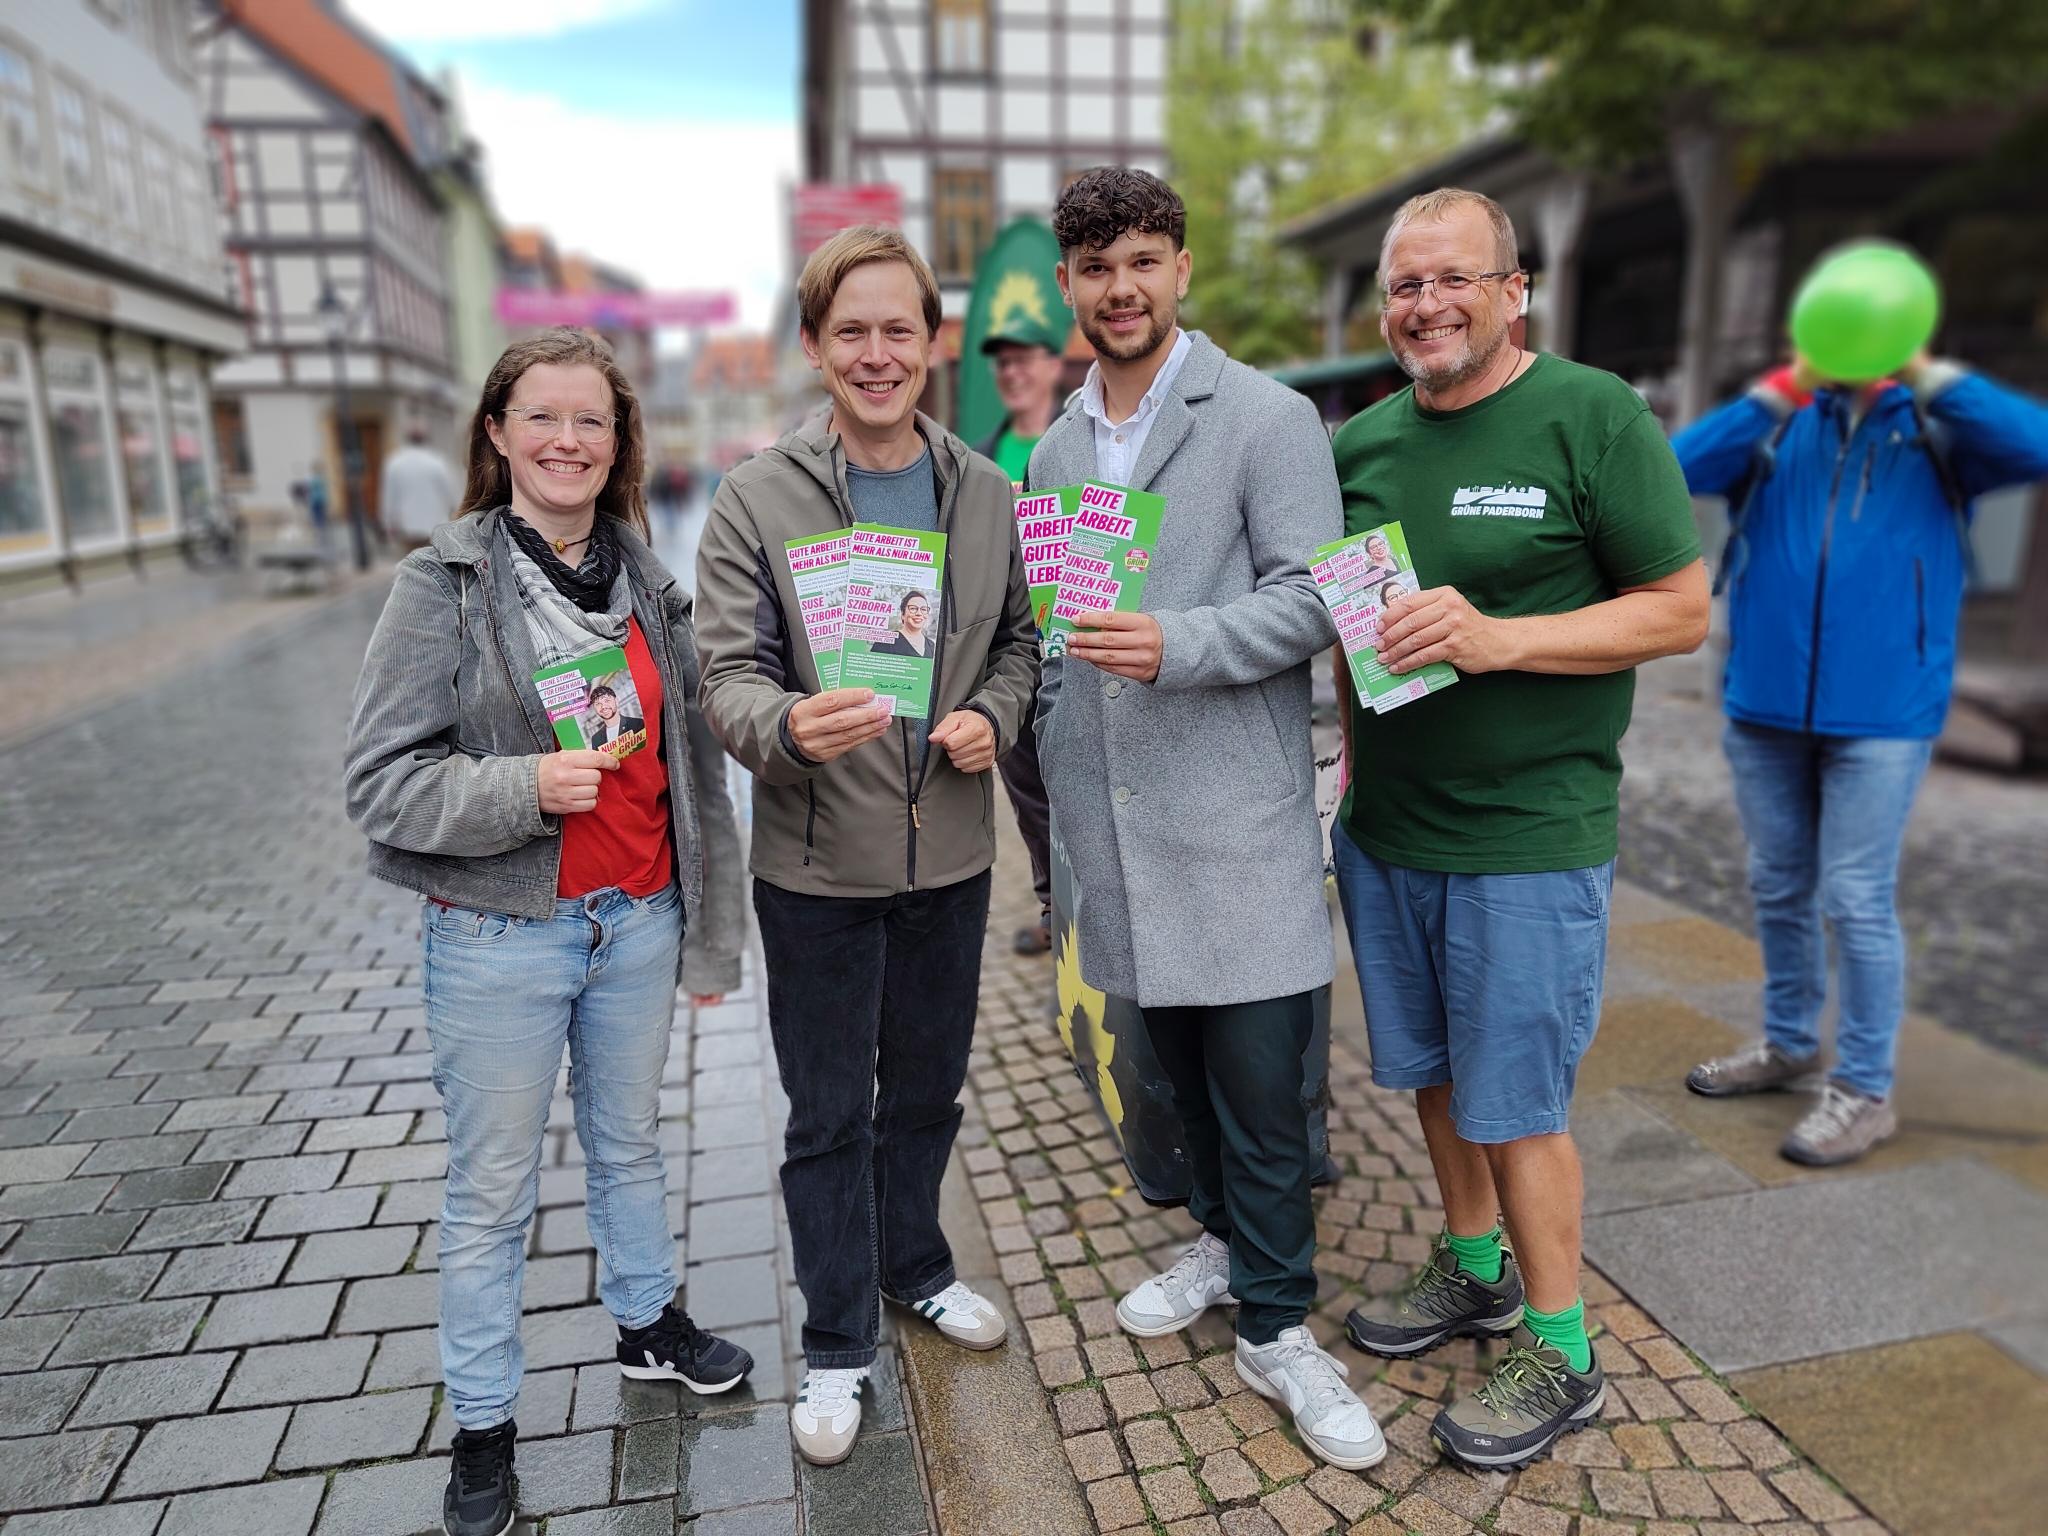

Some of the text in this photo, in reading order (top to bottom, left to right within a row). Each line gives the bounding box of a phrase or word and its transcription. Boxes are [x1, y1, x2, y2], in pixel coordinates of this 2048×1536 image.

[1018, 497, 1056, 517] GUTE
[1081, 487, 1123, 510] GUTE
[1451, 504, 1544, 519] GRÜNE PADERBORN
[1023, 517, 1075, 540] ARBEIT
[1075, 510, 1132, 536] ARBEIT.
[789, 537, 850, 559] GUTE ARBEIT IST
[854, 532, 918, 548] GUTE ARBEIT IST
[852, 544, 876, 555] MEHR
[876, 547, 891, 558] ALS
[891, 549, 908, 560] NUR
[909, 551, 931, 562] LOHN.
[1024, 541, 1069, 562] GUTES
[1331, 552, 1346, 565] SUSE
[792, 558, 814, 571] MEHR
[815, 555, 830, 566] ALS
[831, 552, 847, 563] NUR
[1065, 555, 1111, 577] UNSERE
[1312, 561, 1331, 575] GUTE
[1029, 565, 1063, 584] LEBE
[1061, 568, 1120, 595] IDEEN FÜR
[1339, 564, 1364, 581] SEIDLITZ
[848, 584, 873, 597] SUSE
[1058, 587, 1112, 610] SACHSEN-
[801, 597, 825, 610] SUSE
[847, 599, 895, 614] SZIBORRA-
[1054, 604, 1085, 618] ANH
[1332, 602, 1353, 618] SUSE
[805, 606, 845, 624] SZIBORR
[846, 612, 886, 627] SEIDLITZ
[1337, 605, 1379, 629] SZIBORRA-
[808, 622, 844, 638] SEIDLIT
[1343, 619, 1377, 640] SEIDLITZ
[541, 678, 556, 688] DEINE
[544, 680, 584, 697] FÜR EINEN HARZ
[547, 697, 557, 706] MIT
[601, 731, 633, 752] NUR MIT
[619, 734, 646, 753] GRÜN.
